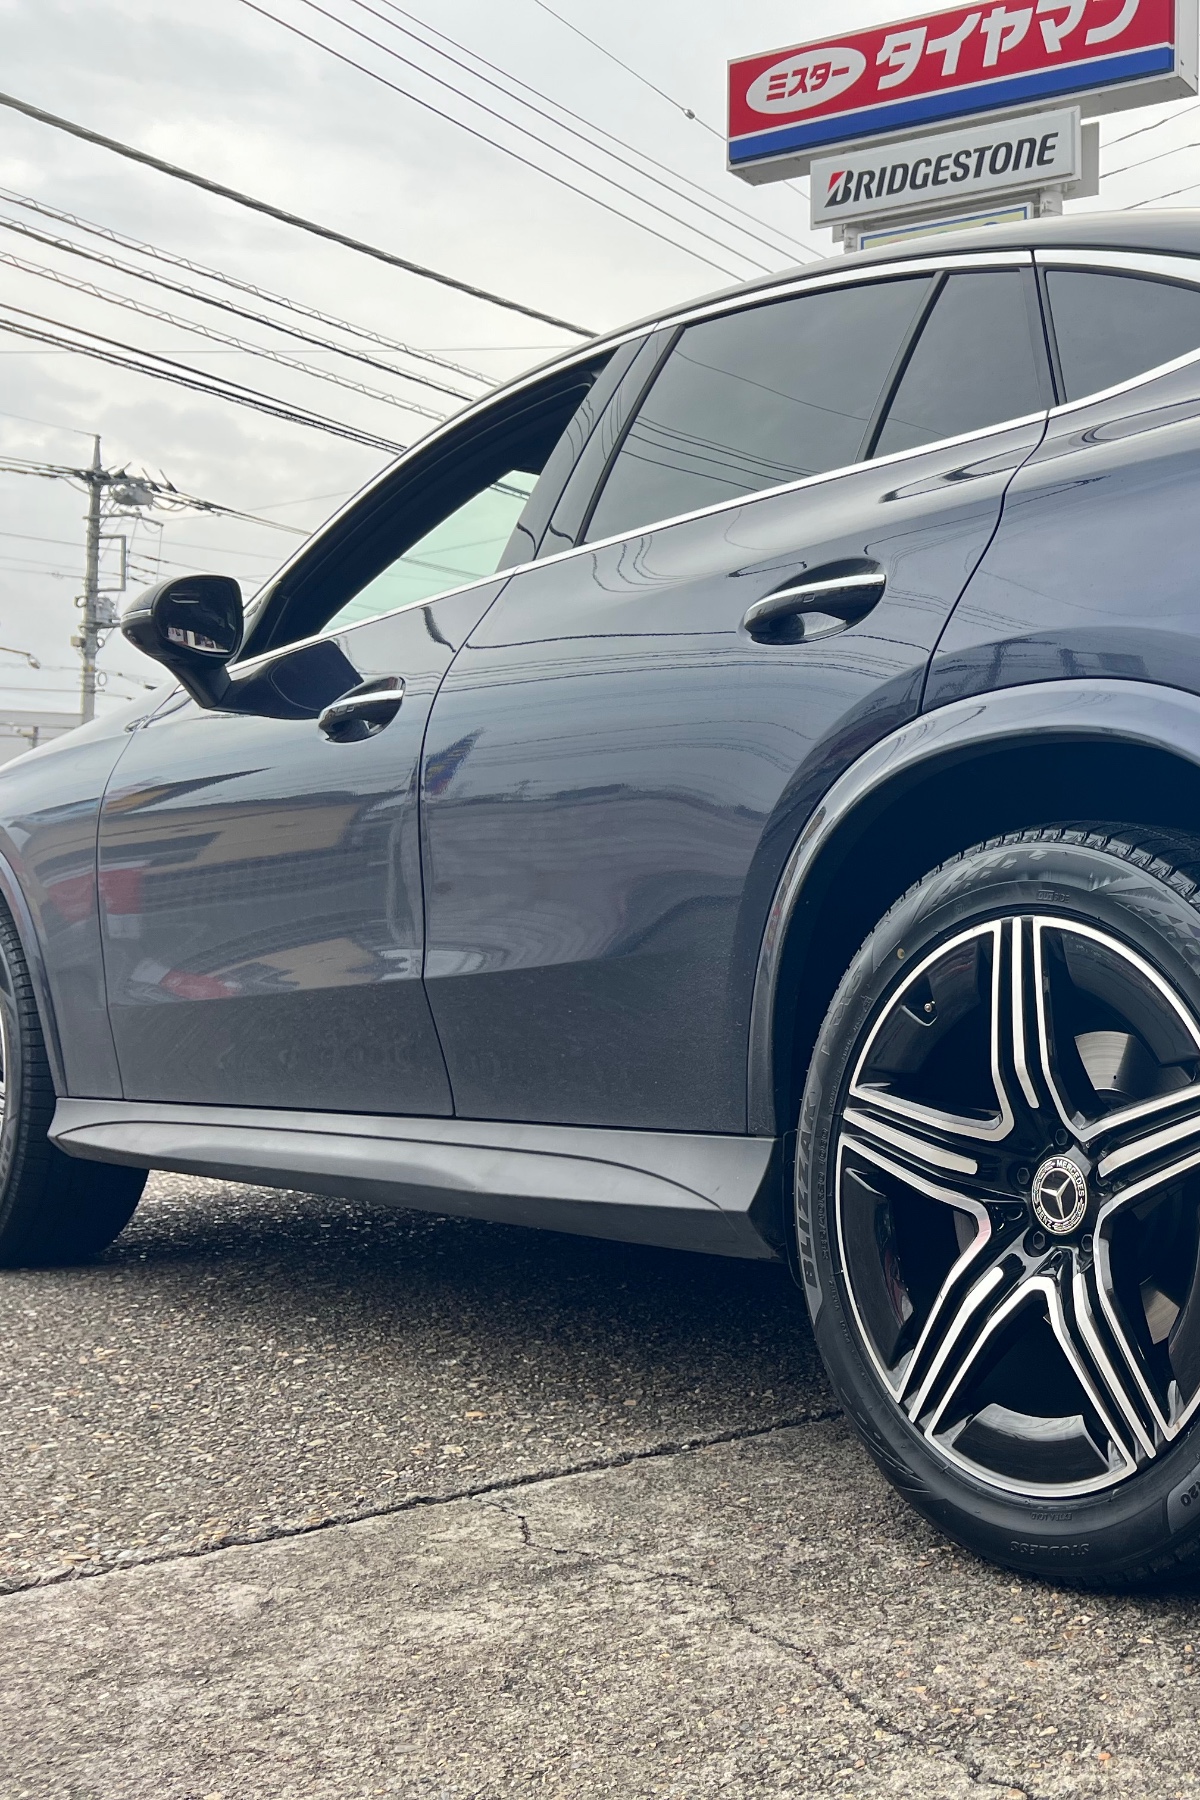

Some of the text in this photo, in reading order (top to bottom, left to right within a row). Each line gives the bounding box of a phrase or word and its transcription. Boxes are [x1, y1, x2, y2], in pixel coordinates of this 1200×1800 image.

[765, 0, 1140, 102] ミスター タイヤマン
[823, 131, 1059, 208] BRIDGESTONE
[798, 1094, 817, 1289] BLIZZAK
[1056, 1159, 1085, 1197] MERCEDES
[1036, 1206, 1053, 1228] BENZ
[1010, 1540, 1090, 1556] STUDLESS
